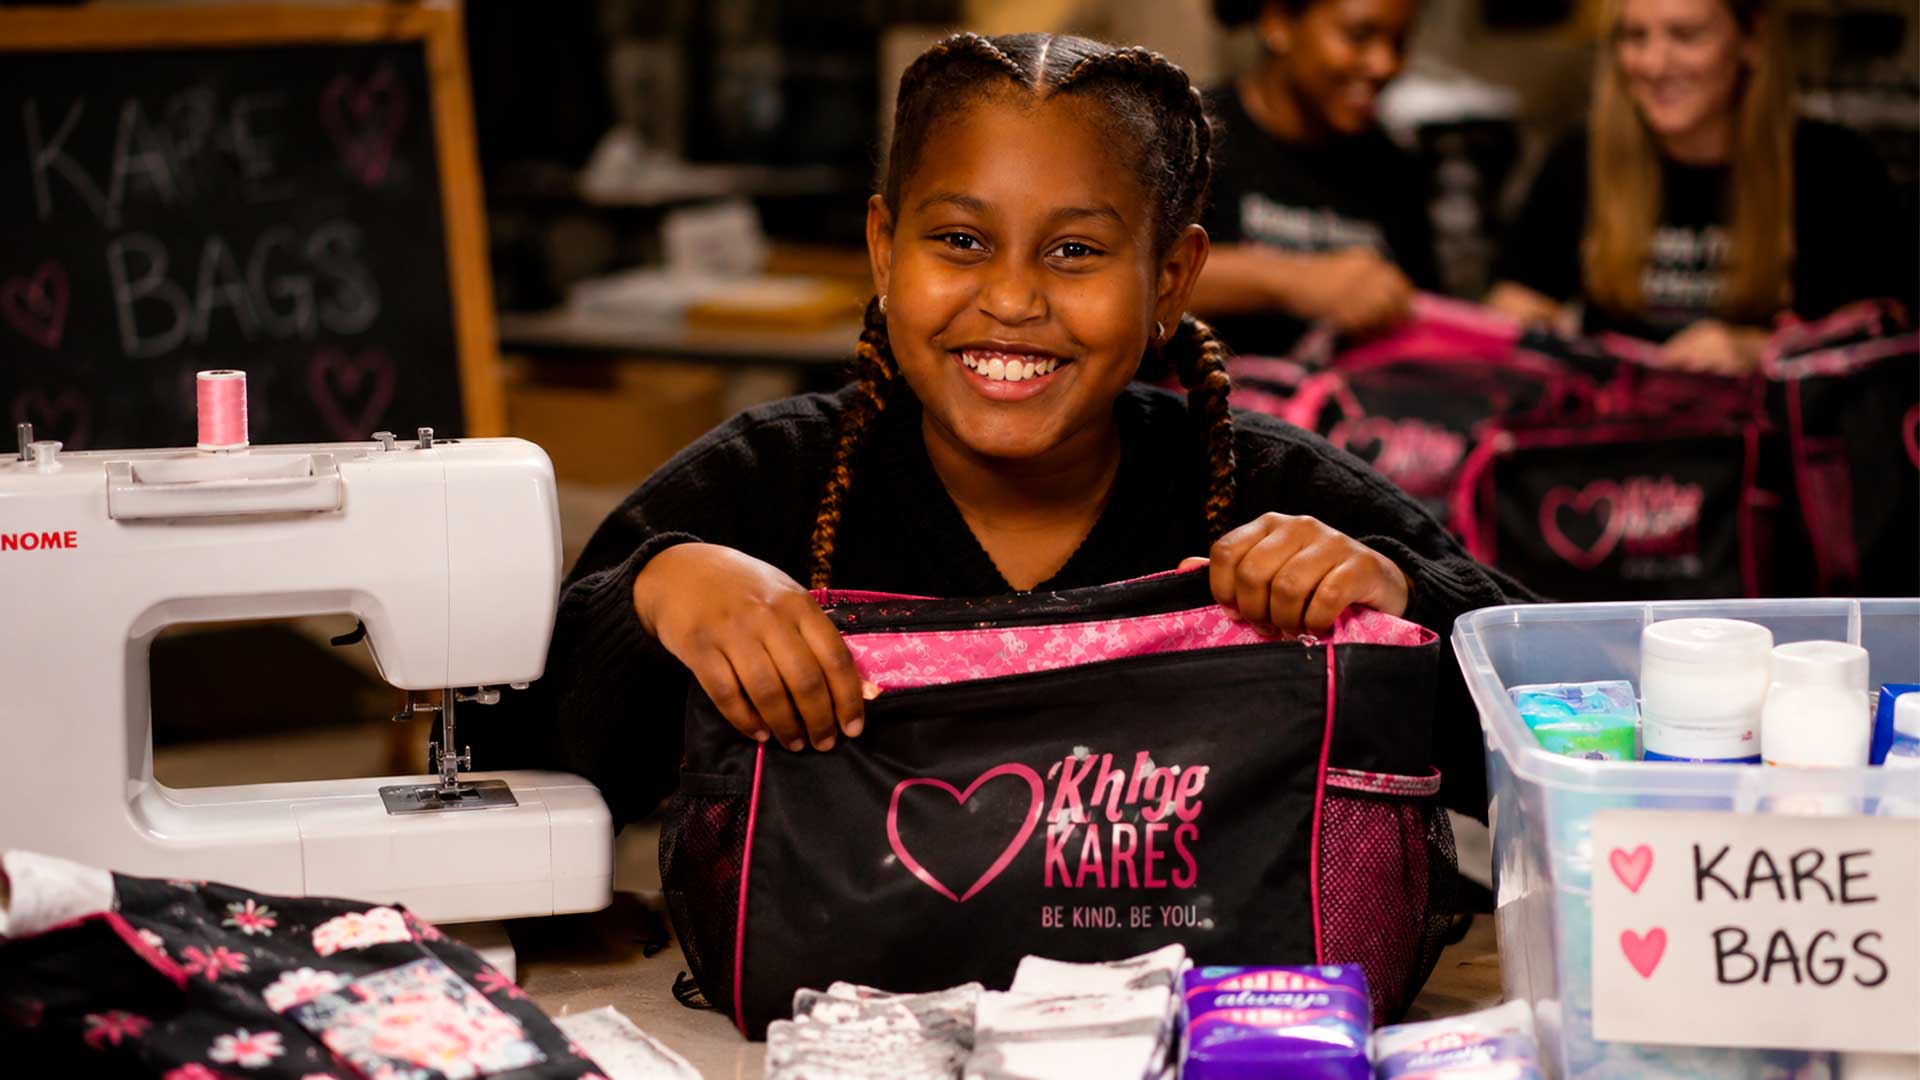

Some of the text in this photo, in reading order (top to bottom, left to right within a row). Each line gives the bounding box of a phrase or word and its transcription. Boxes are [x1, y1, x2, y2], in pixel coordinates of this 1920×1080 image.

[106, 218, 382, 359] BAGS
[1, 531, 78, 551] NOME
[1043, 822, 1200, 889] KARES
[1692, 842, 1879, 904] KARE
[1042, 905, 1204, 928] BE KIND. BE YOU.
[1711, 926, 1889, 988] BAGS
